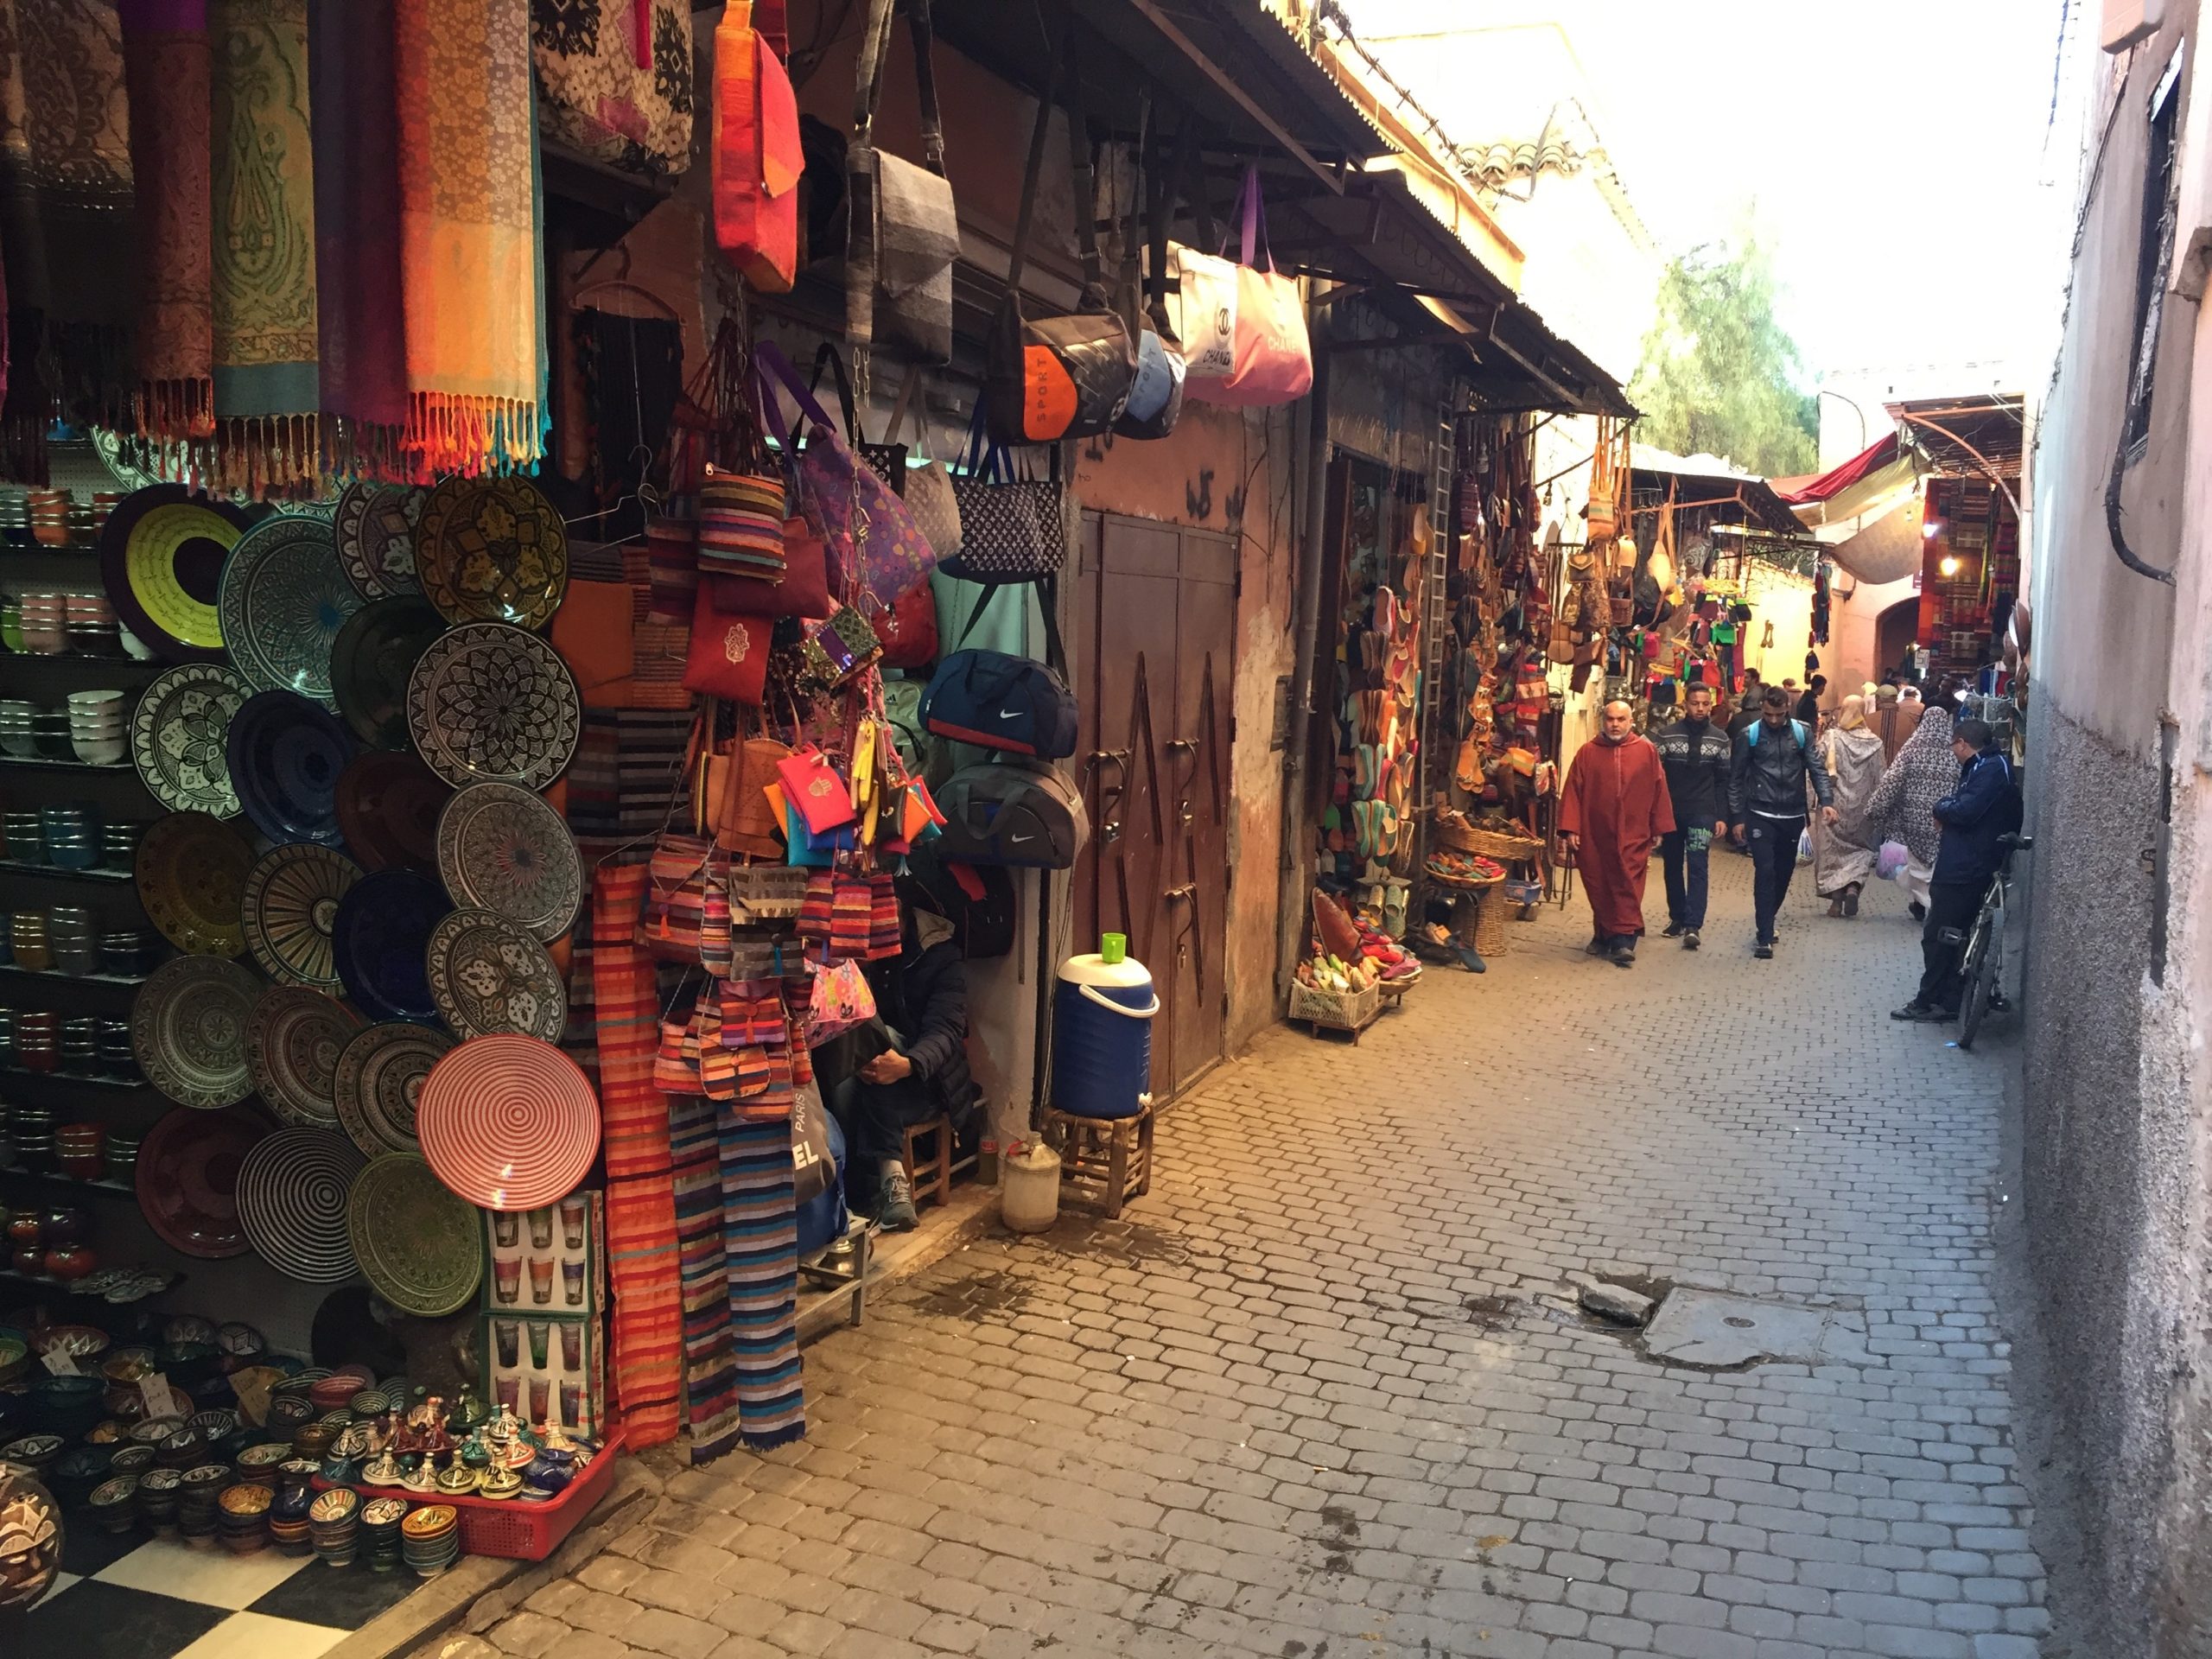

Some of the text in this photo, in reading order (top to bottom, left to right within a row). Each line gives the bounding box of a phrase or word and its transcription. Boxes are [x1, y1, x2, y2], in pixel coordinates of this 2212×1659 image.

[1203, 349, 1231, 366] CHANE
[1037, 359, 1047, 423] SPORT
[795, 1092, 805, 1133] PARIS
